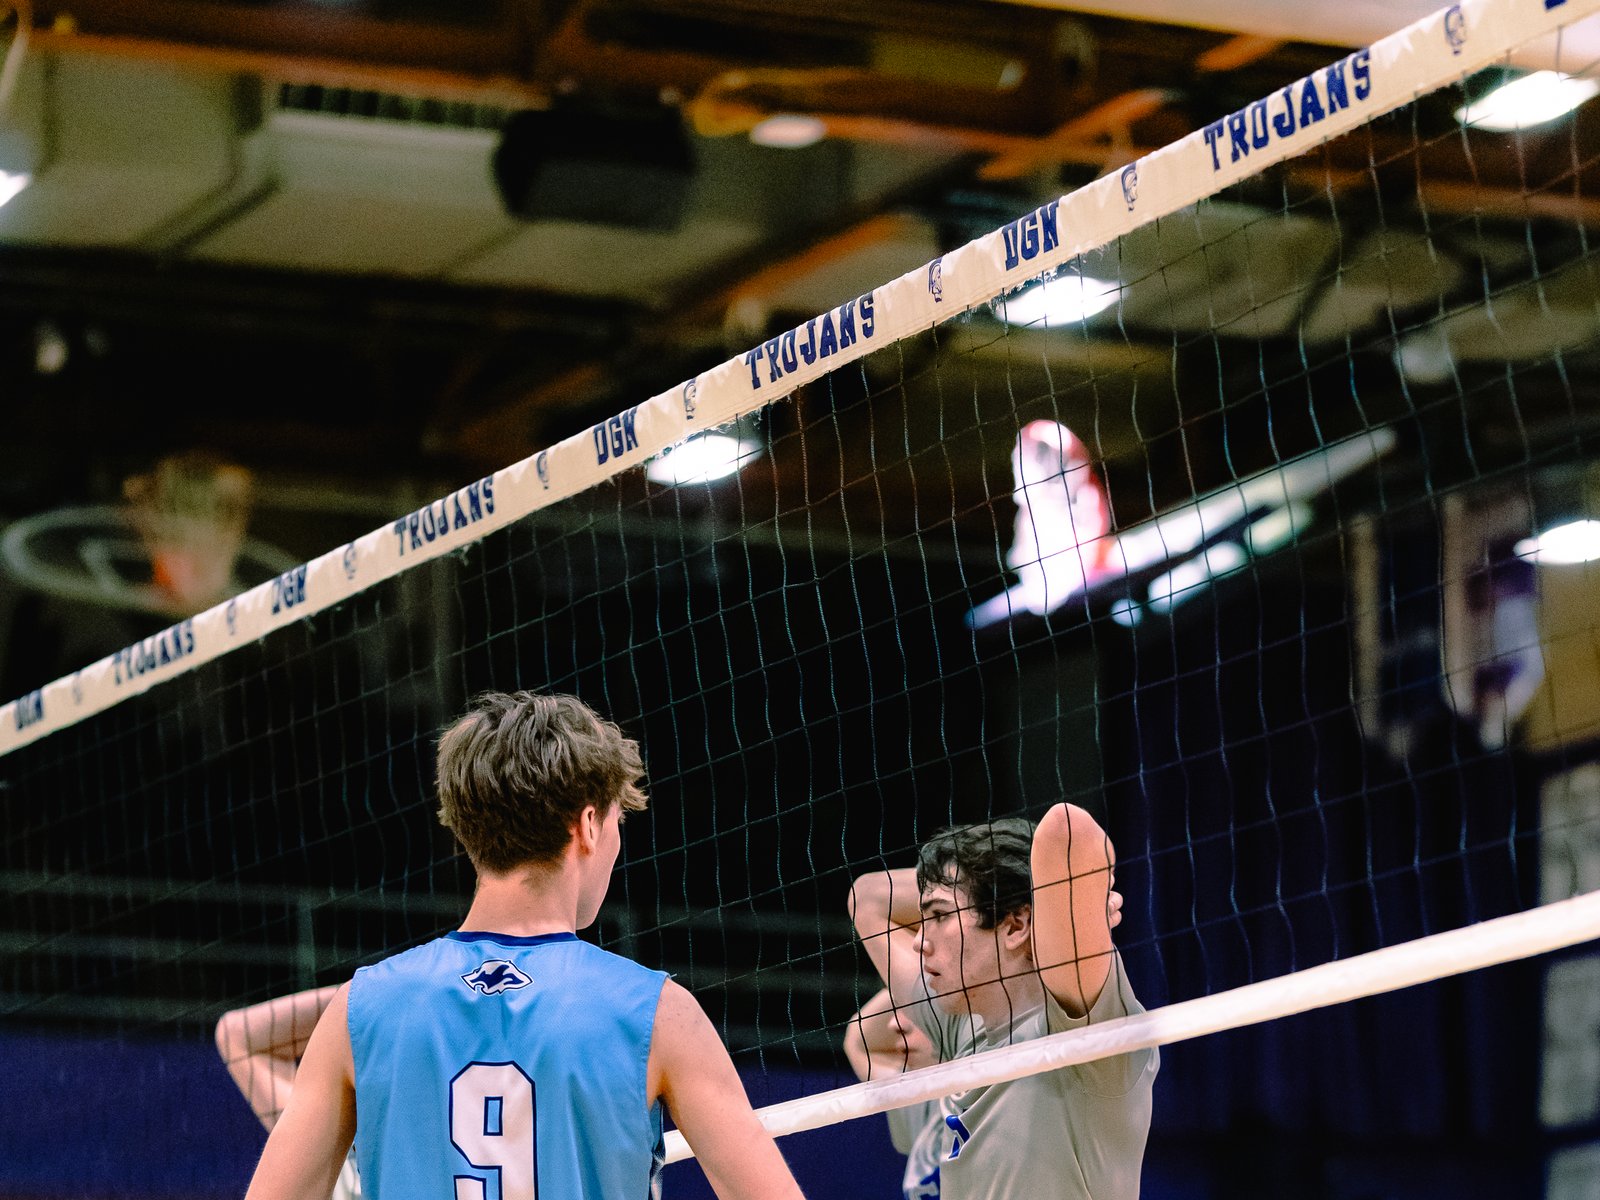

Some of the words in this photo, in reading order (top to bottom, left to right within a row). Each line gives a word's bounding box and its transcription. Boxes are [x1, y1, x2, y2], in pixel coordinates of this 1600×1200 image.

[394, 475, 494, 556] TROJANS
[593, 406, 638, 466] DGN
[745, 290, 875, 390] TROJANS
[1002, 200, 1060, 271] DGN
[1203, 48, 1372, 172] TROJANS
